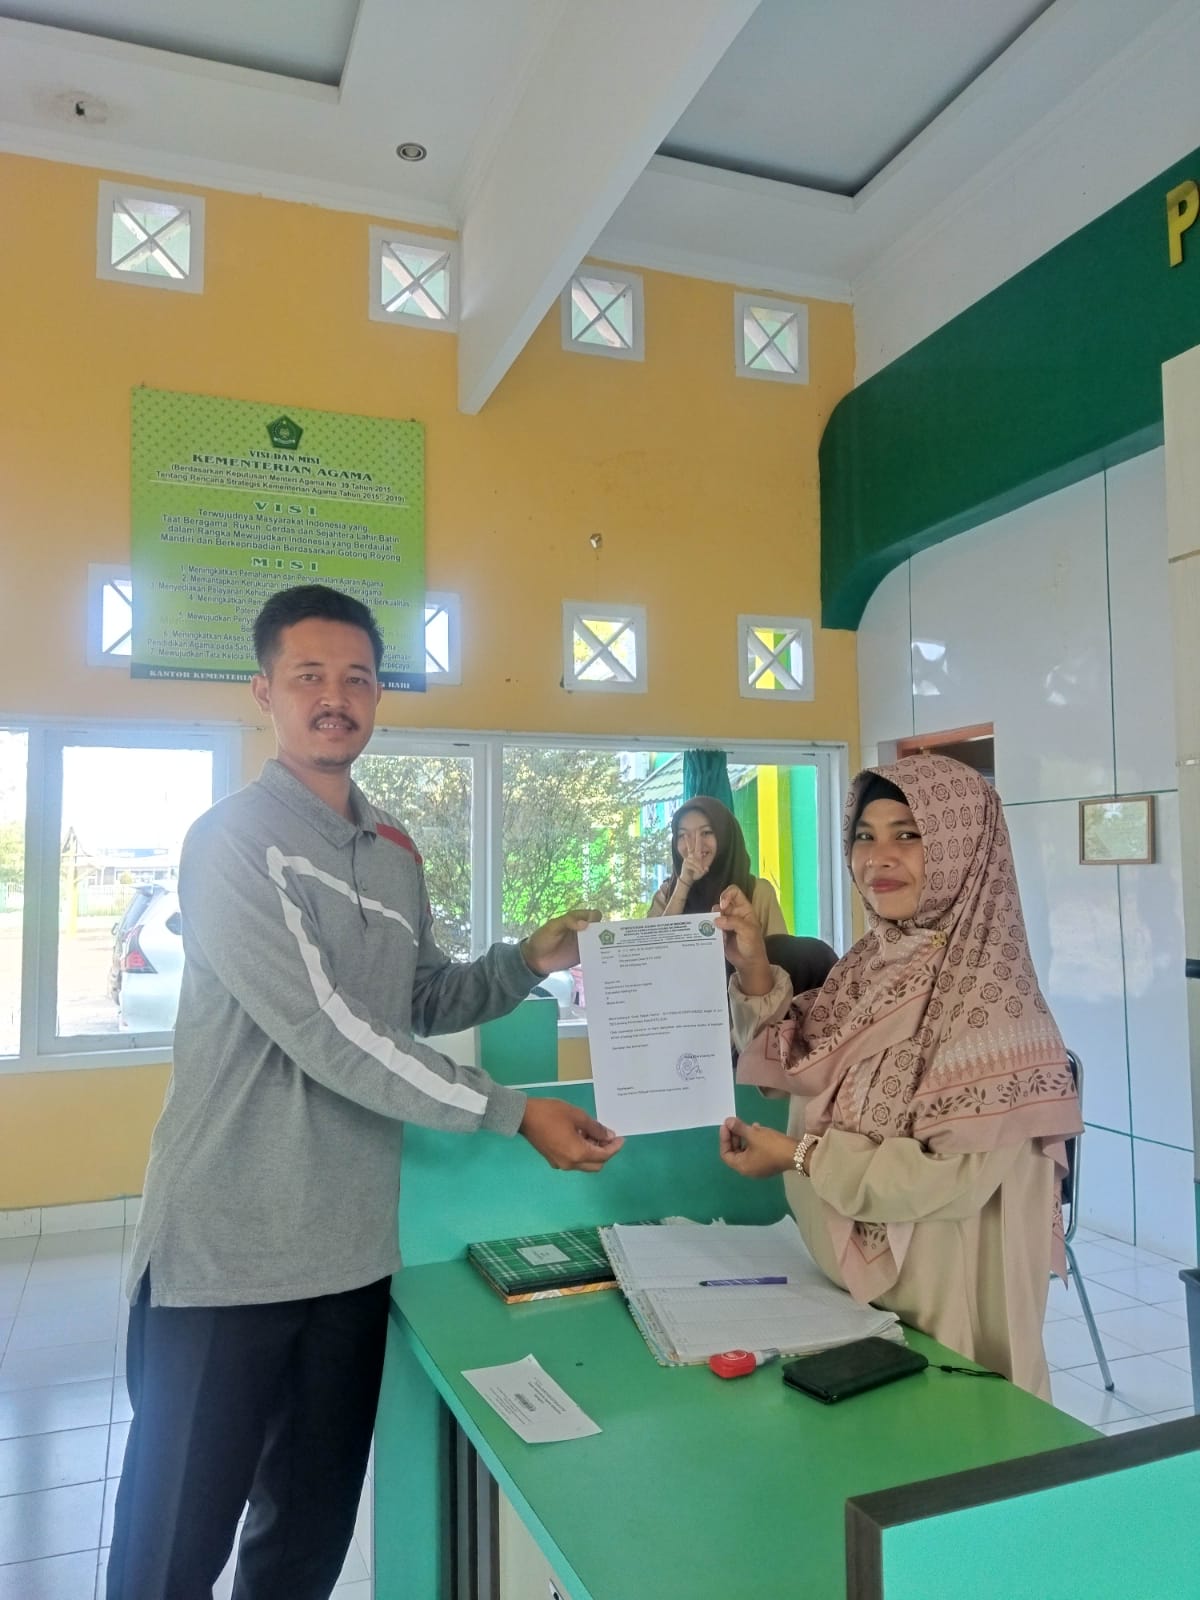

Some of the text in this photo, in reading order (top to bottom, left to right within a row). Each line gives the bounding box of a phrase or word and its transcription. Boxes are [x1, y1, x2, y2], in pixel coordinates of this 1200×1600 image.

[192, 454, 372, 481] KEMENTERIAN AGAMA
[249, 450, 320, 464] VISI DAN MISI
[156, 471, 188, 481] Tentang
[190, 473, 225, 484] Rencana
[227, 478, 260, 488] Strategis
[263, 482, 310, 492] Kementerian
[312, 487, 337, 497] Agama
[340, 490, 361, 498] Tahun
[226, 469, 268, 480] Keputusan
[270, 474, 298, 483] Menteri
[300, 477, 325, 487] Agama
[352, 483, 373, 491] Tahun
[162, 514, 180, 523] Taat
[265, 524, 296, 534] Cerdas
[298, 527, 314, 535] dan
[316, 528, 354, 541] Sejahtera
[357, 533, 377, 541] Lahir
[379, 534, 400, 543] Batin
[199, 508, 368, 533] Terwujudnya Masyarakat Indonesia yang
[160, 533, 401, 562] Mandiri dan Berkepribadian Berdasarkan Gotong Royong
[168, 524, 195, 534] dalam
[197, 527, 231, 539] Rangka
[233, 530, 287, 543] Mewujudkan
[289, 536, 330, 546] Indonesia
[332, 541, 352, 549] yang
[159, 581, 206, 592] Menyediakan
[208, 585, 244, 595] Pelayanan
[188, 565, 237, 576] Meningkatkan
[239, 569, 281, 579] Pemahaman
[362, 579, 384, 588] Agama
[190, 575, 240, 586] Memantapkan
[350, 587, 382, 597] Beragama
[149, 669, 190, 678] KANTOR
[194, 671, 254, 681] KEMENTERIA
